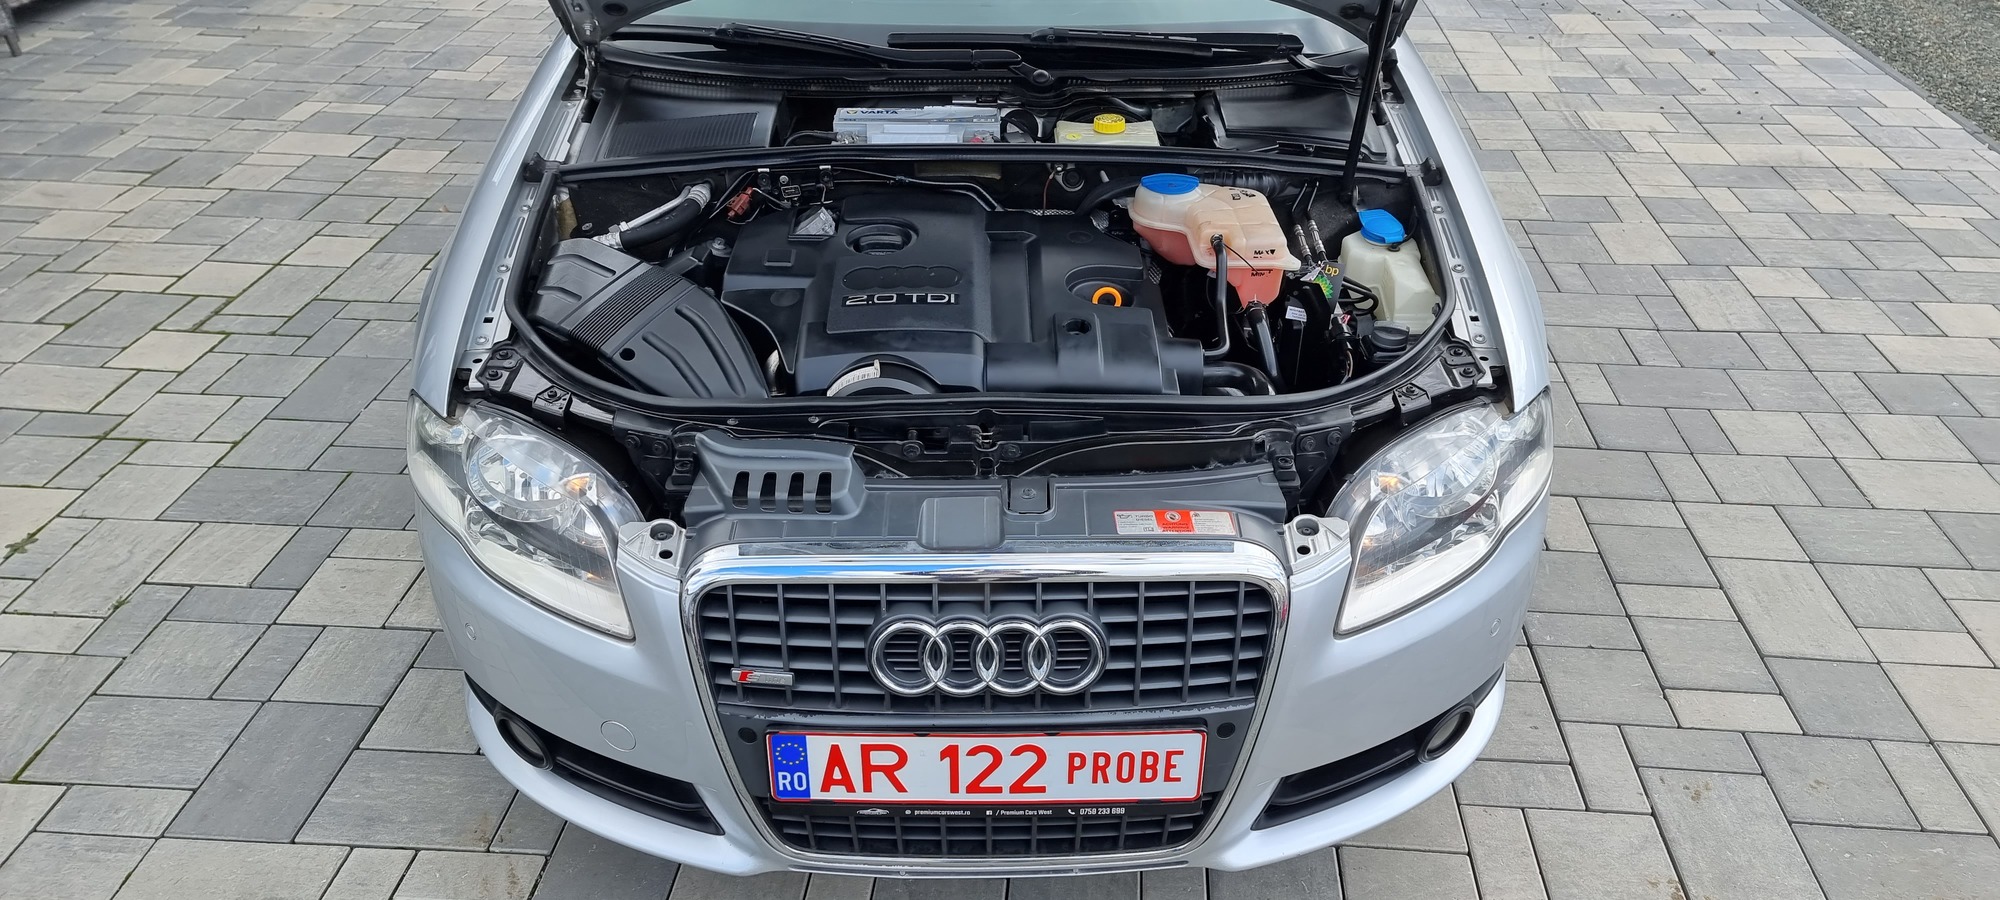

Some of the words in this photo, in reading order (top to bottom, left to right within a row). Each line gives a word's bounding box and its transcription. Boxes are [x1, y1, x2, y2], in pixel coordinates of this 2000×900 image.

[1325, 264, 1340, 277] bp
[845, 294, 897, 306] 2.0
[904, 293, 955, 304] TDI
[819, 743, 909, 794] AR
[939, 743, 1048, 795] 122
[1067, 748, 1185, 785] PROBE
[778, 771, 807, 791] RO
[1097, 807, 1111, 815] 233
